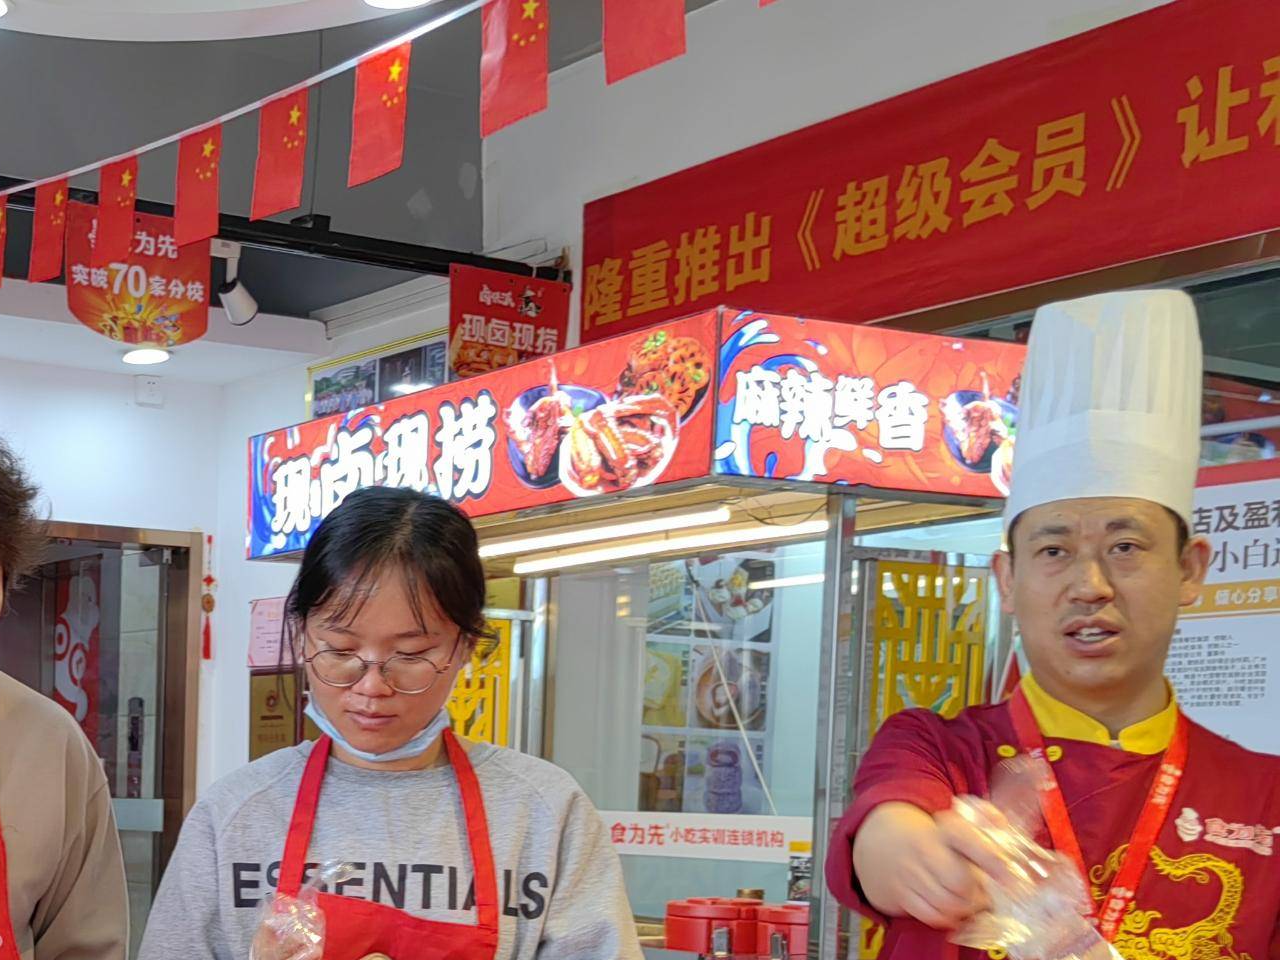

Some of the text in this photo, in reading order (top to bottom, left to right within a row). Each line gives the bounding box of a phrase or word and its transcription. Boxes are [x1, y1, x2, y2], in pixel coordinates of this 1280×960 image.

[128, 231, 178, 259] 为先
[72, 262, 205, 303] 突破70家分校
[462, 314, 558, 354] 现卤现捞
[732, 365, 929, 451] 麻辣鲜香
[271, 394, 497, 533] 现卤现捞
[610, 822, 666, 846] 食为先
